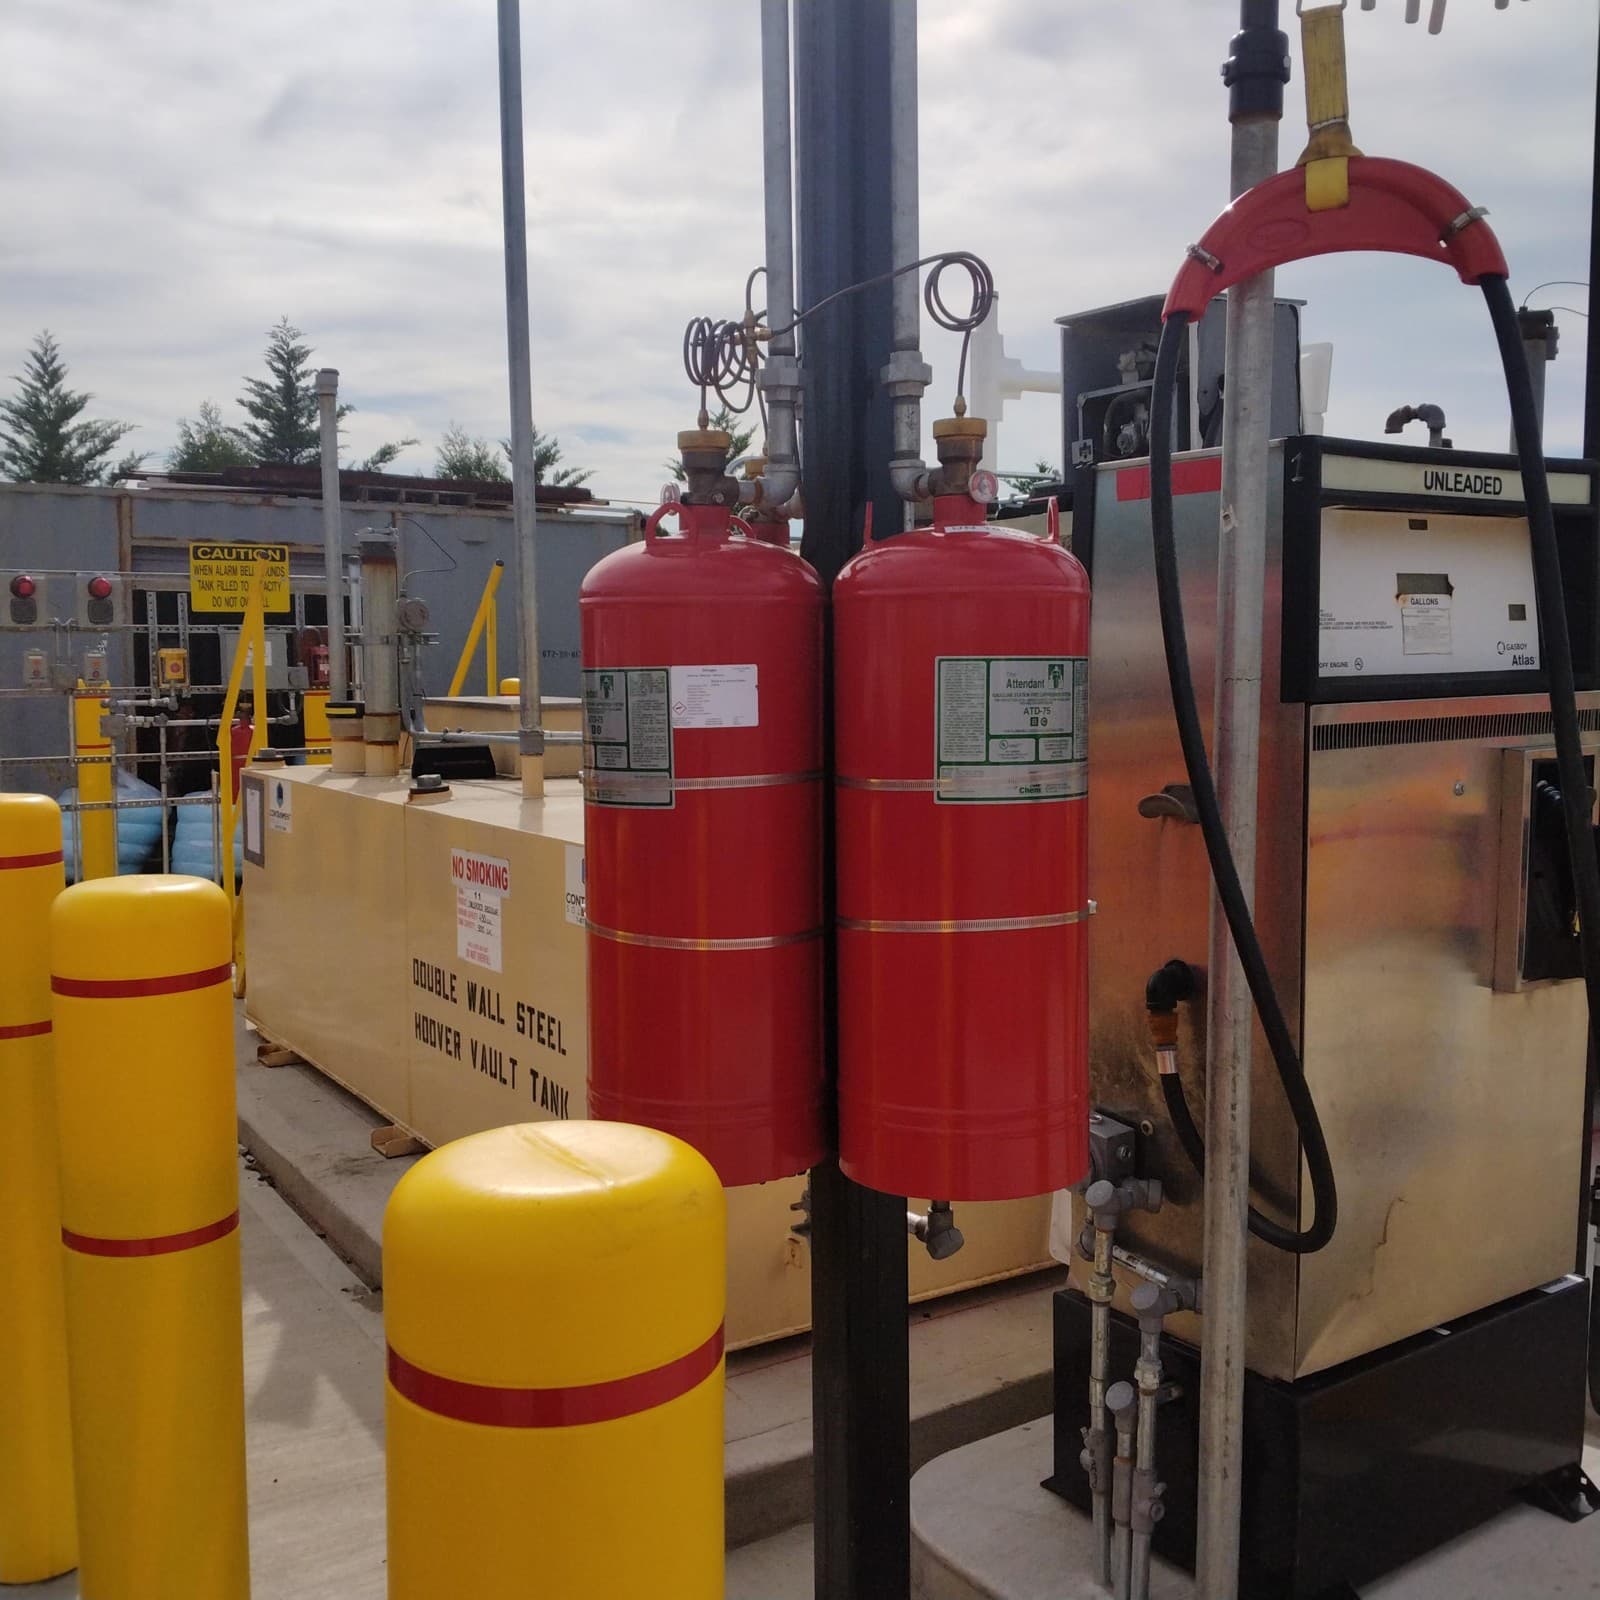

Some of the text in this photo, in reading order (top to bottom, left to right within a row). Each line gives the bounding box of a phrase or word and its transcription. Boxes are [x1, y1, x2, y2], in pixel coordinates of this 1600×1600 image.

[1424, 470, 1503, 496] UNLEADED
[197, 547, 281, 561] CAUTION
[195, 564, 213, 576] WHEN
[216, 564, 238, 577] ALARM
[198, 580, 214, 592] TANK
[217, 580, 238, 592] FILLED
[240, 581, 249, 592] TO
[212, 596, 222, 608] DO
[224, 596, 238, 608] NOT
[1410, 597, 1439, 606] GALLONS
[1511, 654, 1536, 667] Atlas
[1006, 678, 1045, 689] Attendant
[1023, 706, 1052, 716] ATD-75
[452, 855, 509, 891] NO SMOKING
[412, 957, 568, 1057] DOUBLE WALL STEEL
[414, 1011, 569, 1125] HOOVER VAULT TANK
